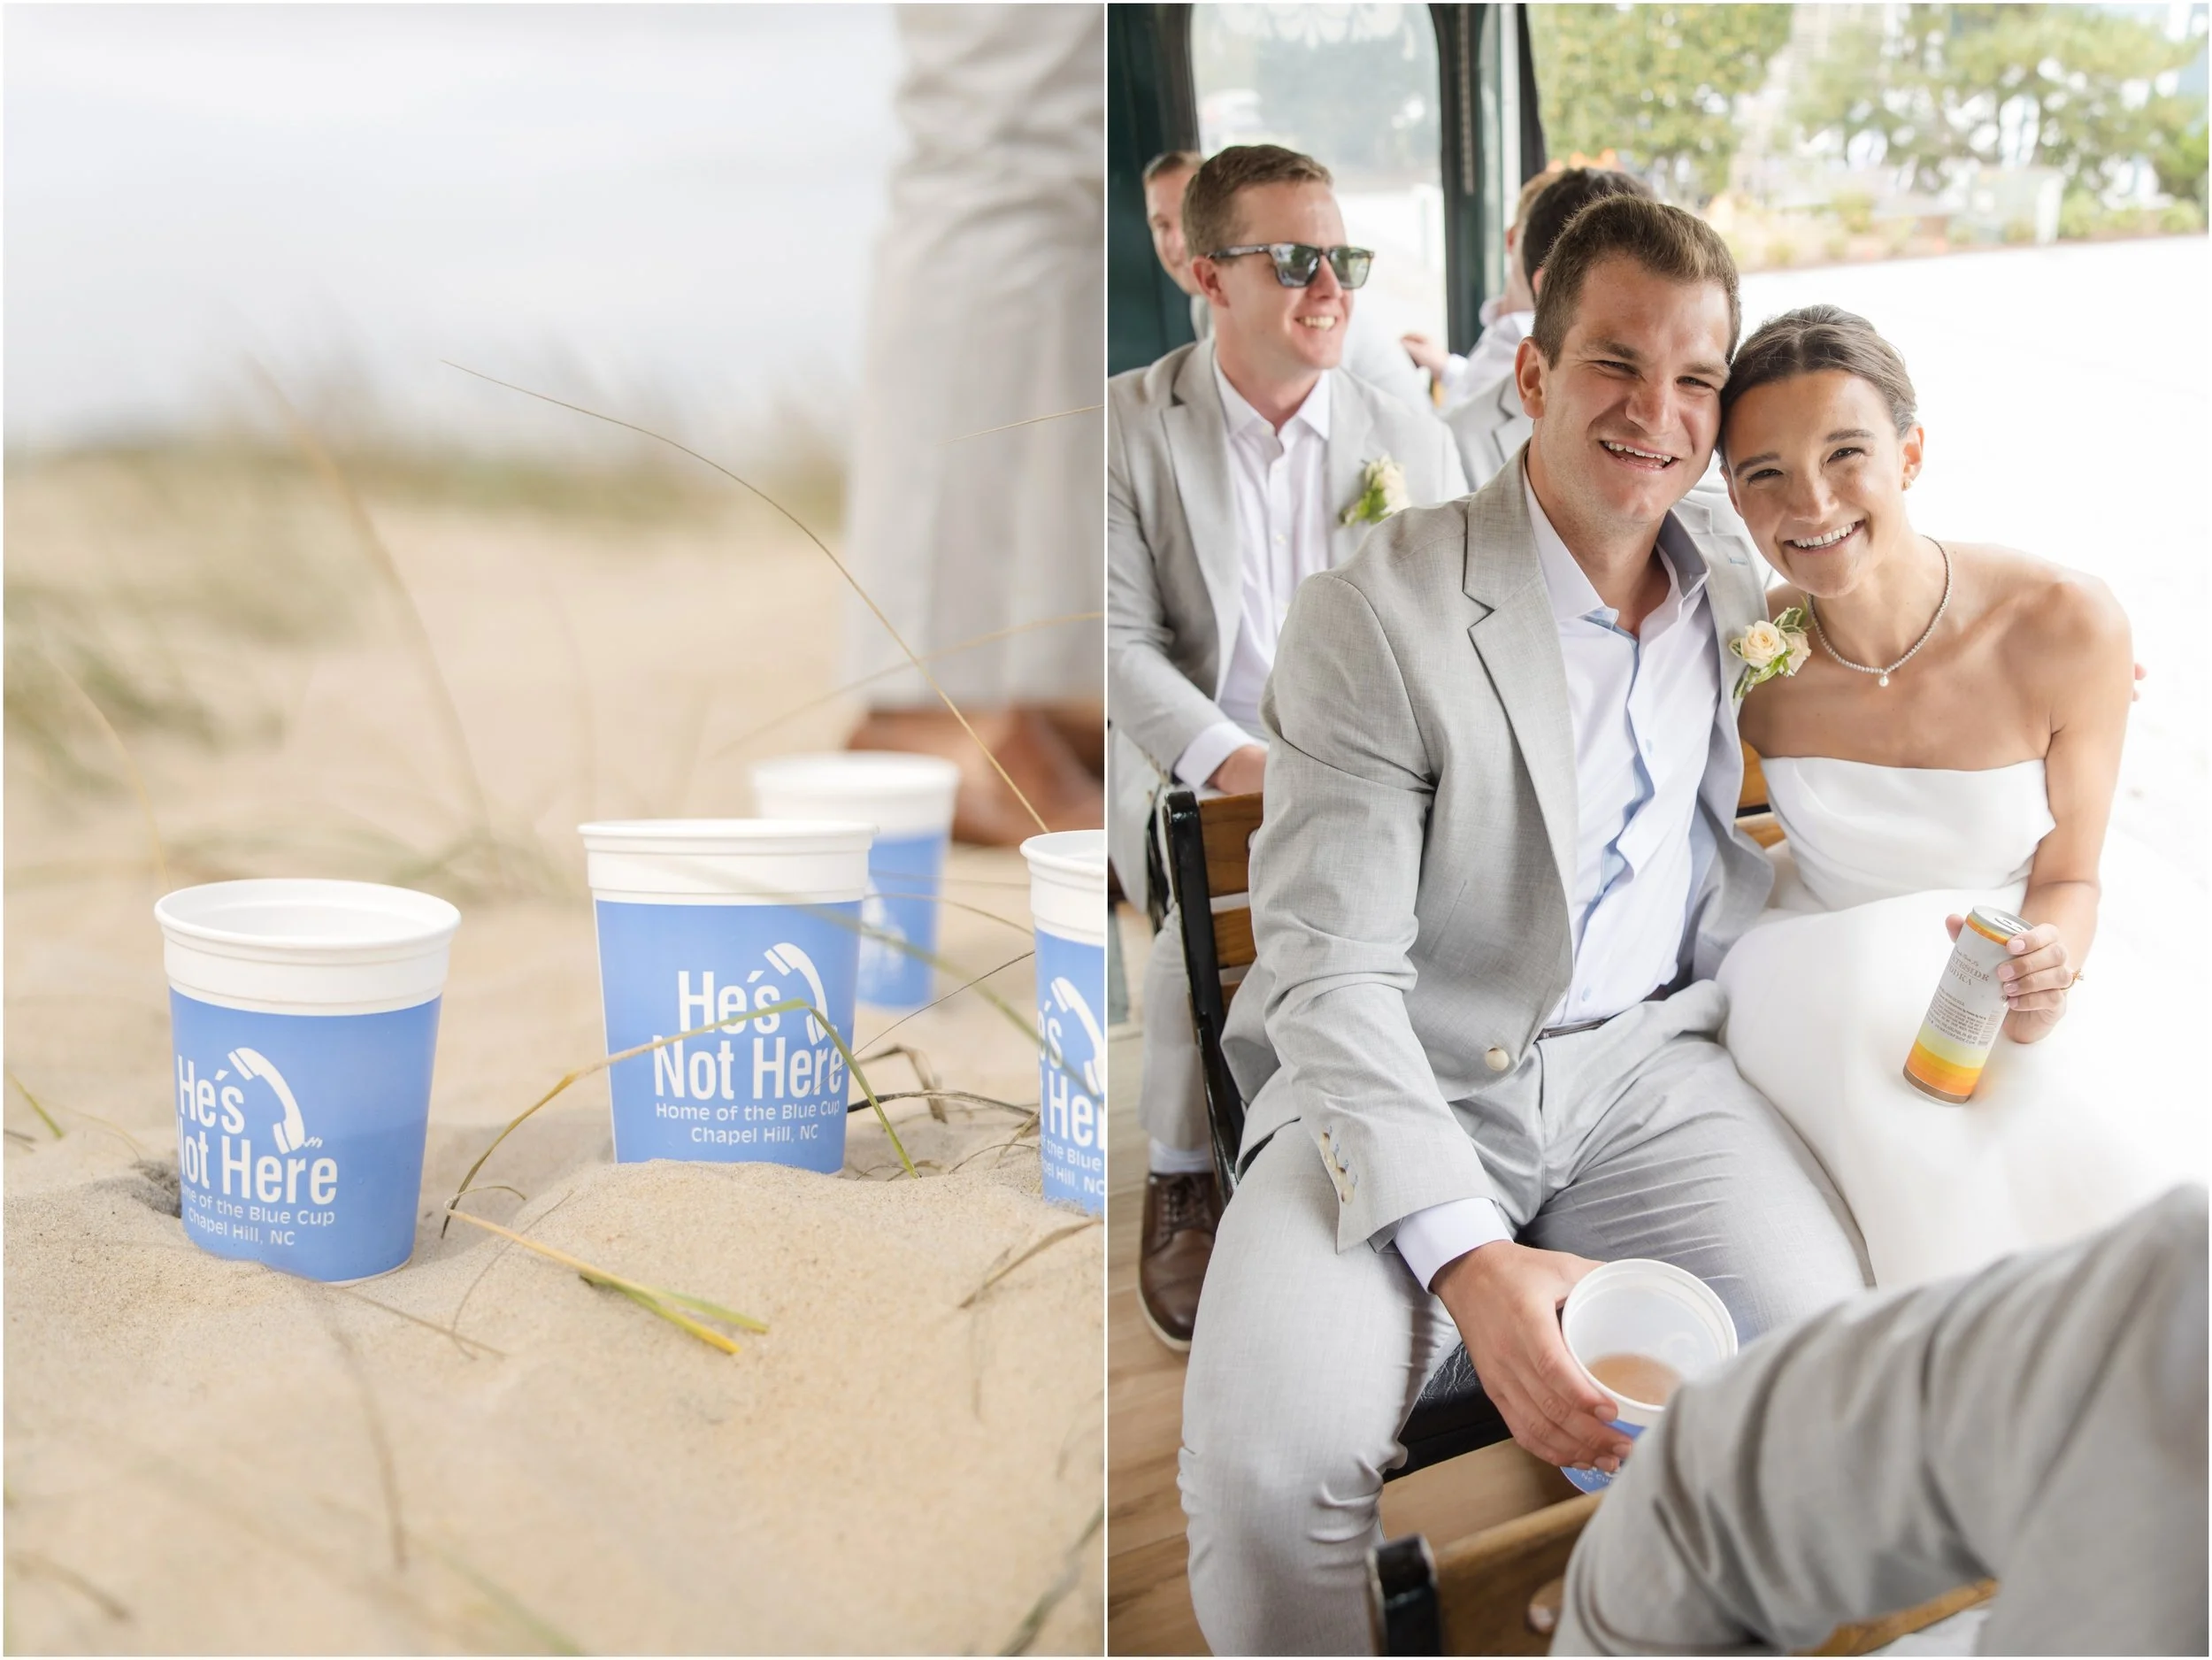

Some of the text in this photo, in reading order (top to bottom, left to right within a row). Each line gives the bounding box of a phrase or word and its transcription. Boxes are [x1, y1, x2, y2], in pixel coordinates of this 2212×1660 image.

[678, 971, 780, 1034] He's
[652, 1034, 844, 1100] Not Here
[656, 1100, 840, 1121] Home of the Blue Cup
[691, 1124, 818, 1145] Chapel Hill, NC
[221, 1135, 338, 1205] Here
[1067, 1148, 1102, 1172] Blue
[188, 1207, 296, 1246] Chapel Hill, NC
[199, 1195, 213, 1210] of
[217, 1200, 244, 1218] the
[249, 1206, 291, 1225] Blue
[297, 1210, 335, 1226] Cup
